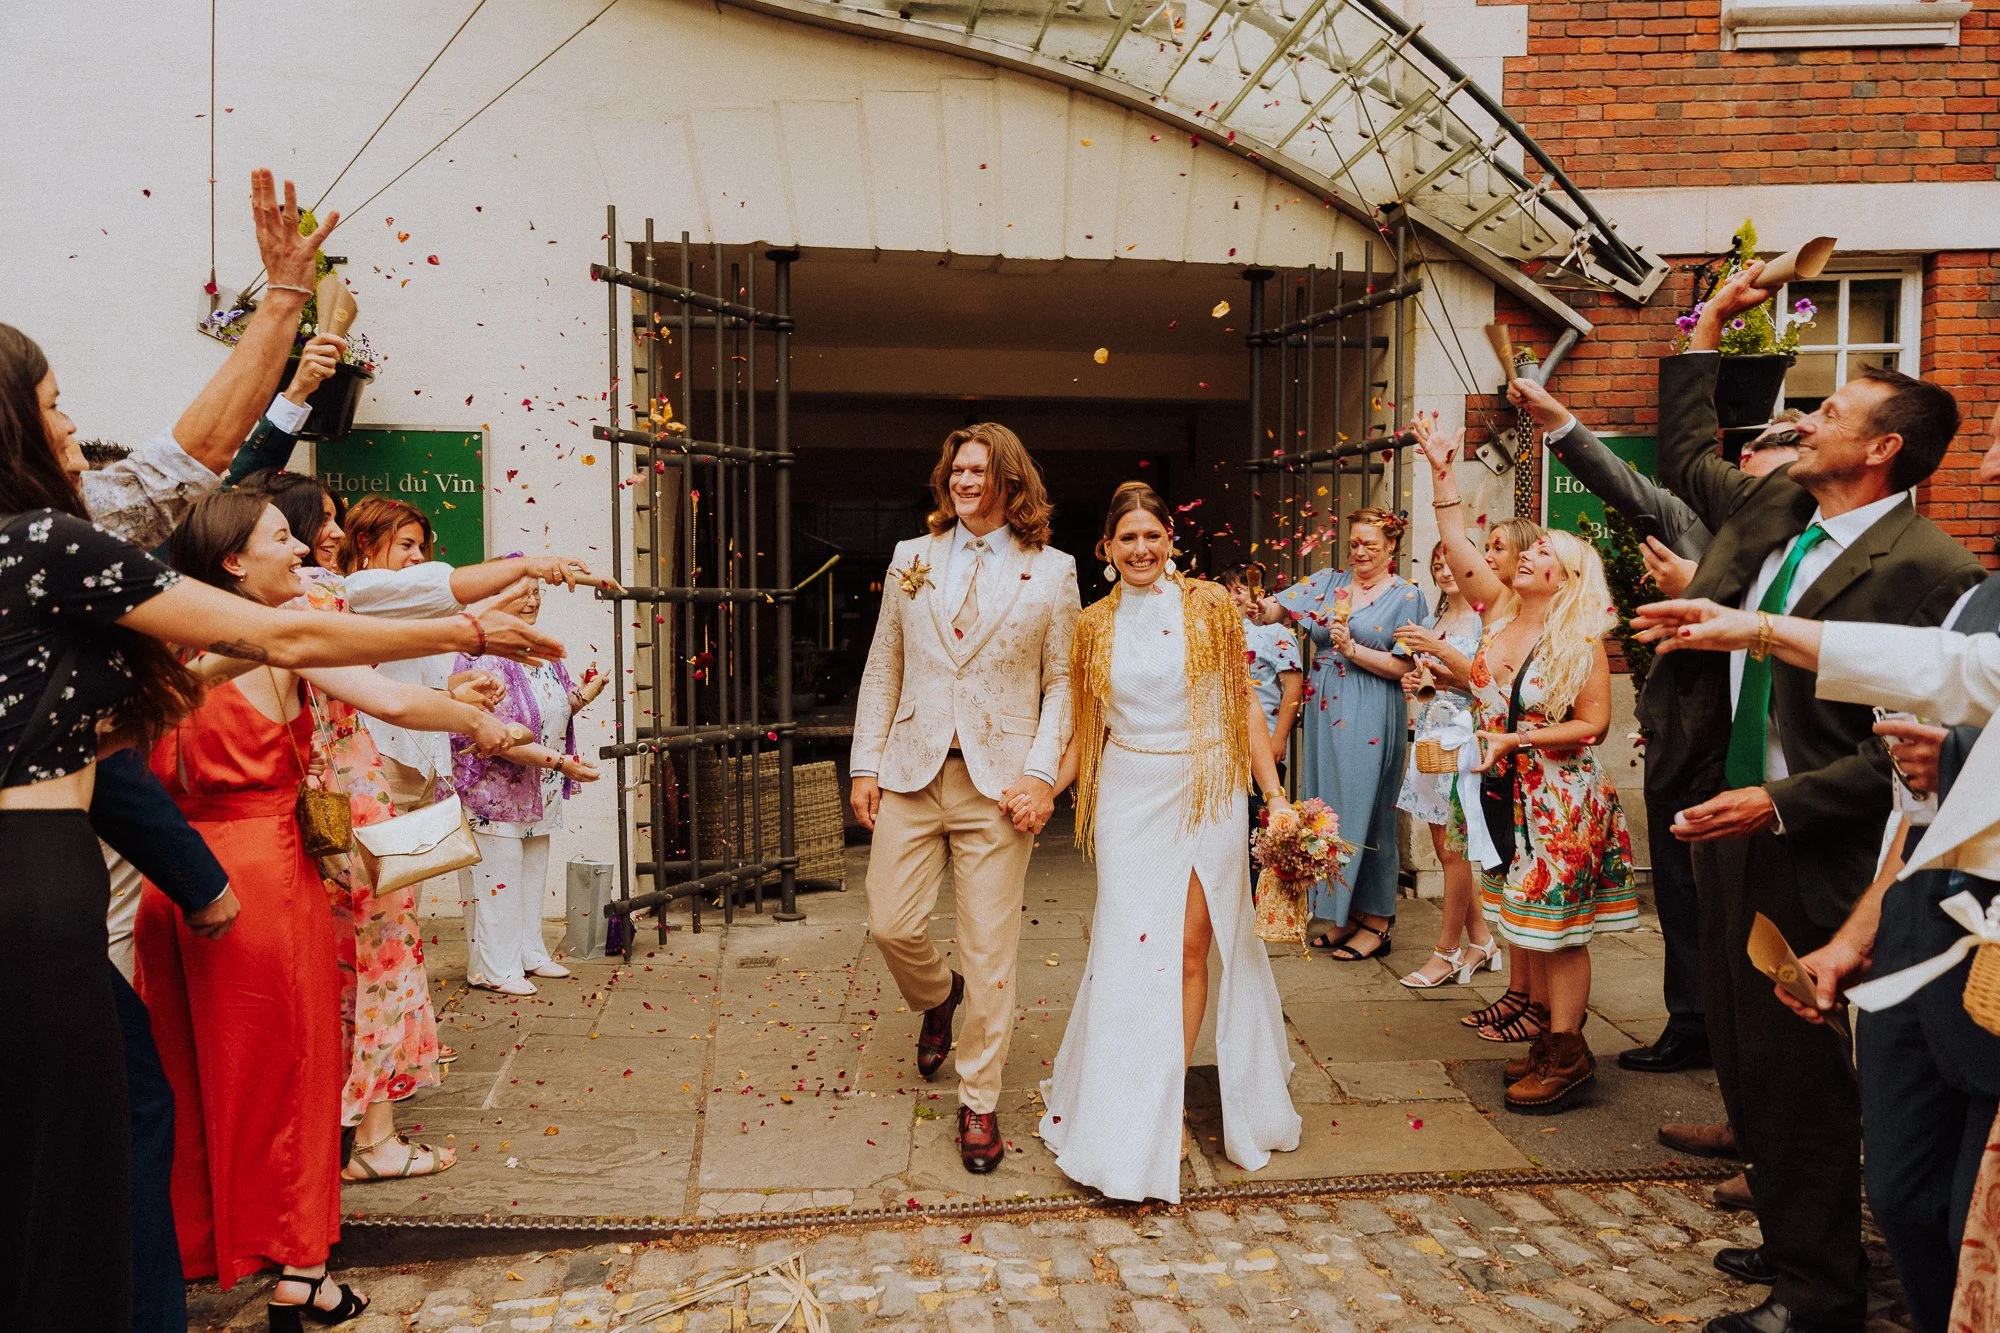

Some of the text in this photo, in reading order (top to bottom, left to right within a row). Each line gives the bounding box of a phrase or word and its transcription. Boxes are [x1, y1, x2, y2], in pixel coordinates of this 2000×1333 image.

[324, 472, 476, 493] Hotel du Vin
